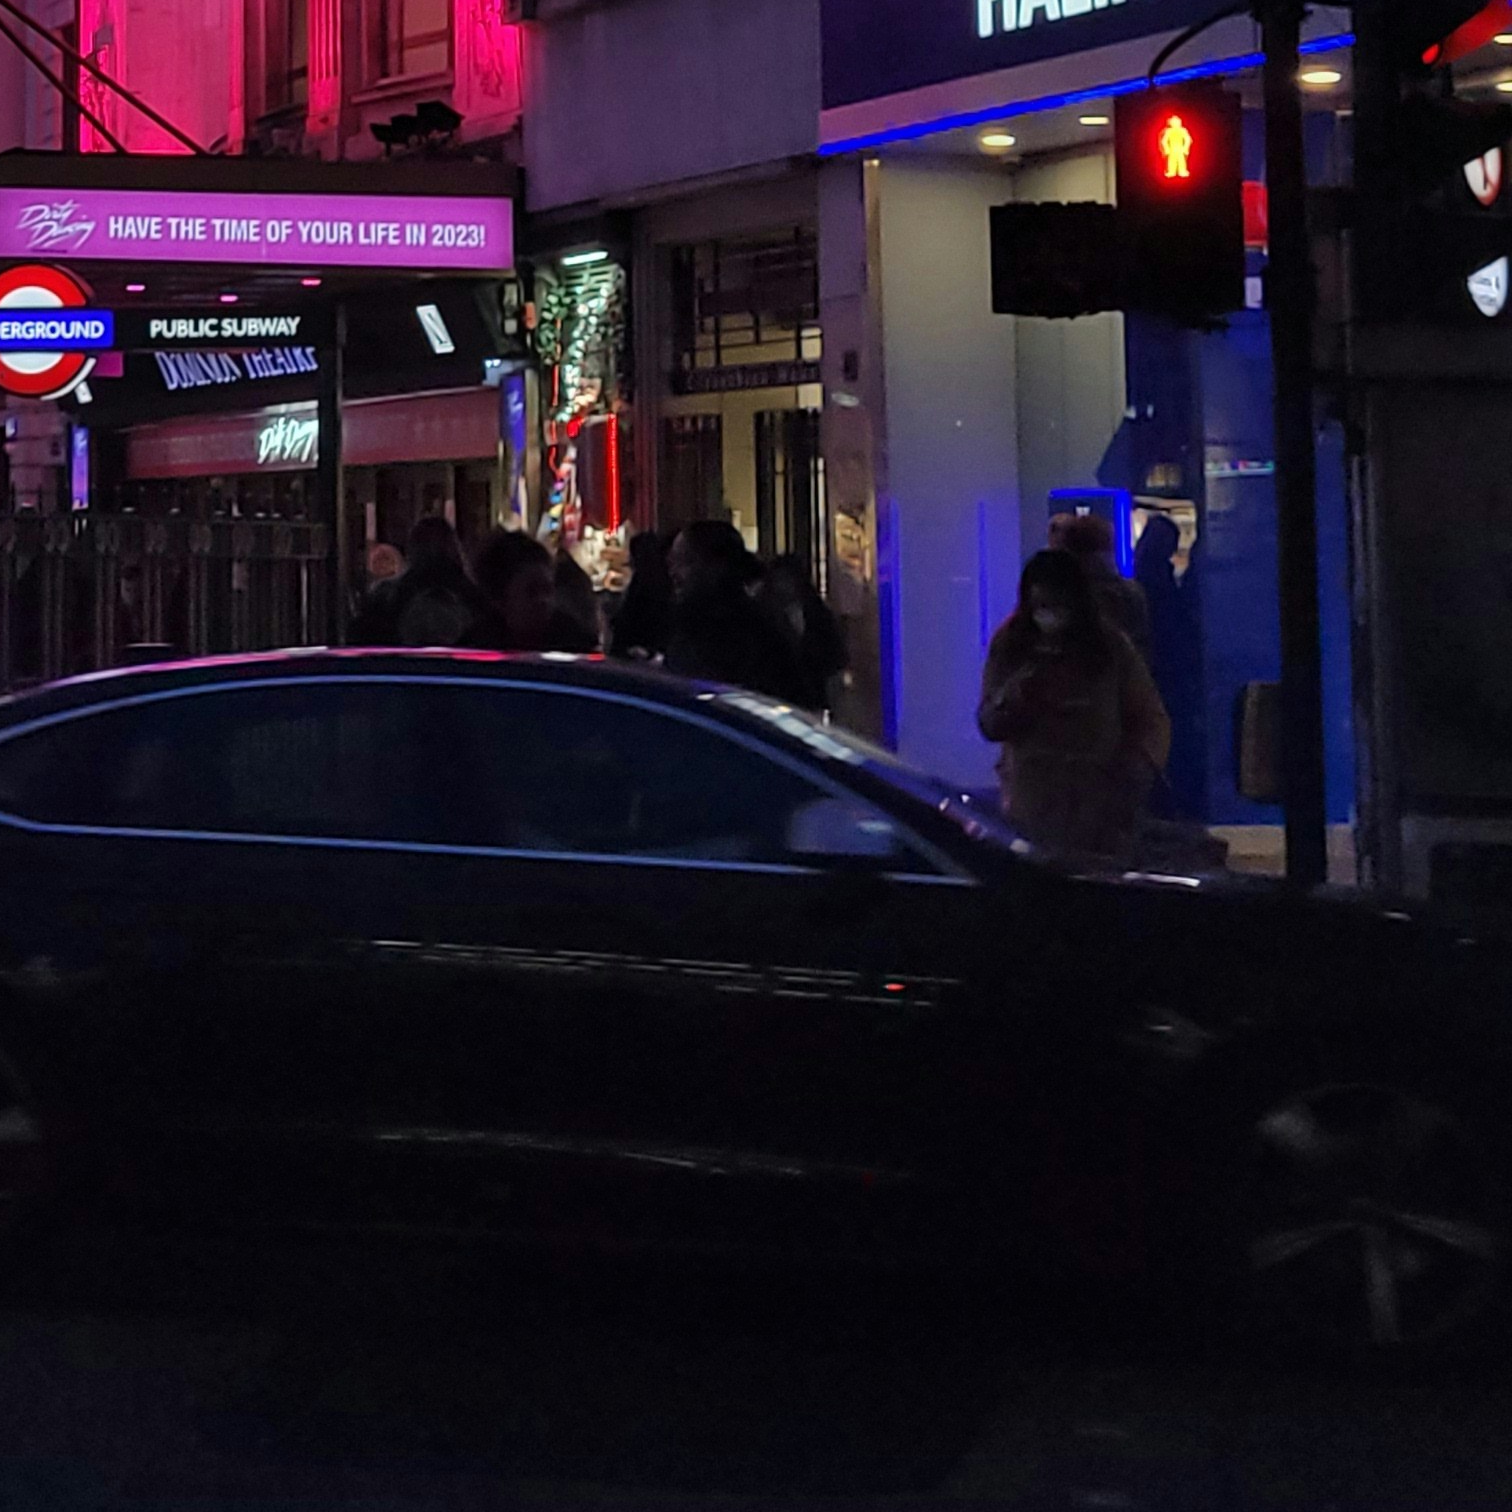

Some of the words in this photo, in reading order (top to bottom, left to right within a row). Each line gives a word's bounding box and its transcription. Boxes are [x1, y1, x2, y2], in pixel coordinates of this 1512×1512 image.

[17, 199, 81, 228] Dirty
[109, 215, 162, 240] HAVE
[168, 217, 205, 240] THE
[212, 217, 260, 242] TIME
[266, 219, 293, 244] OF
[298, 219, 352, 245] YOUR
[359, 221, 400, 245] LIFE
[406, 223, 426, 246] IN
[431, 223, 486, 247] 2023!
[150, 318, 219, 339] PUBLIC
[221, 316, 300, 337] SUBWAY
